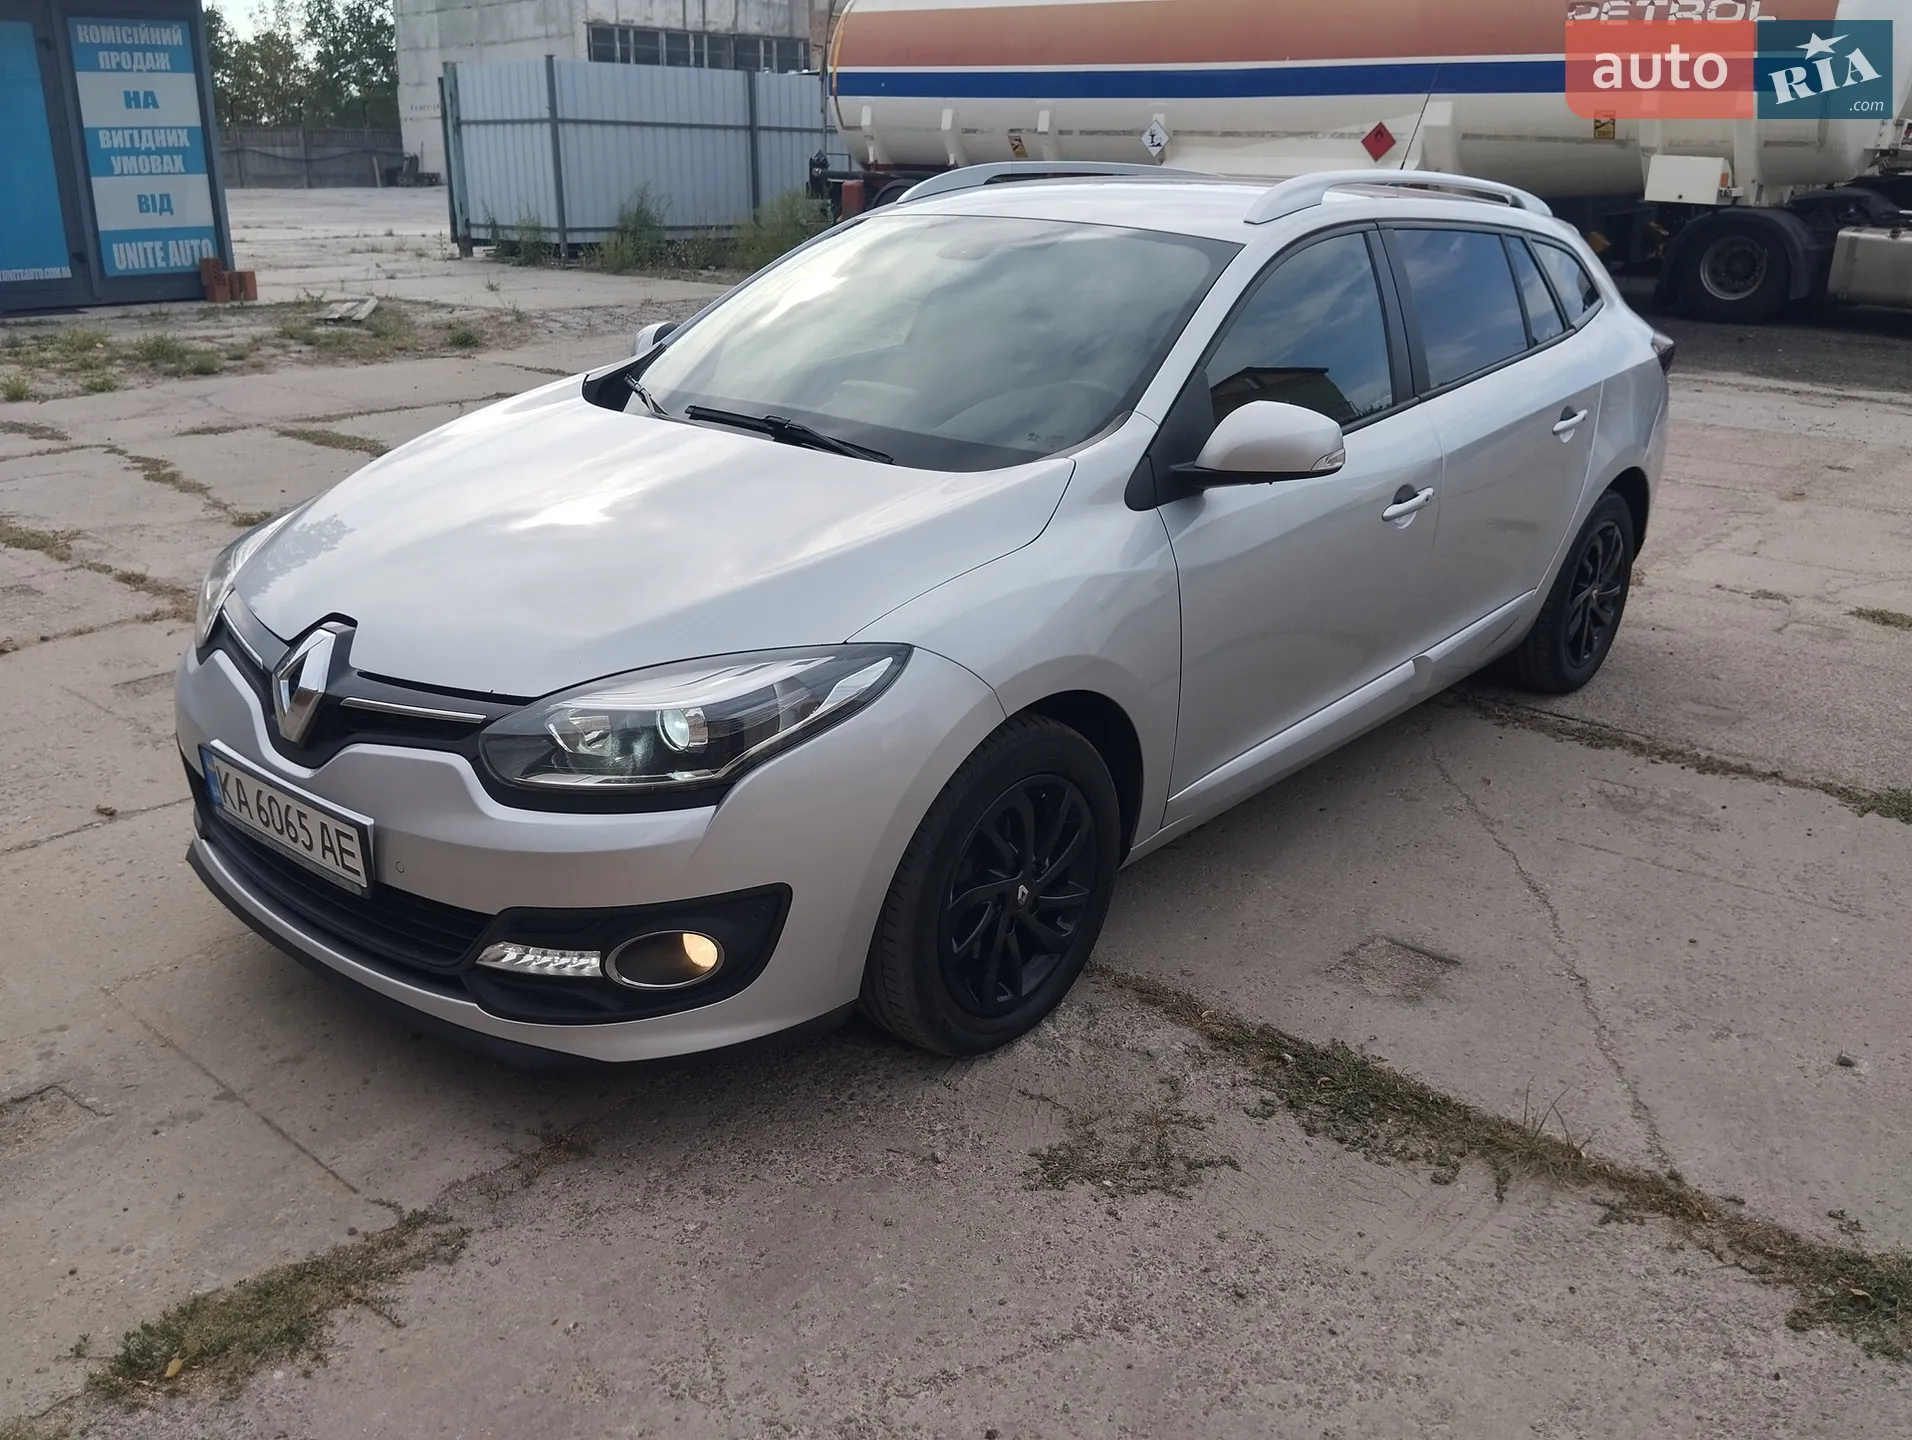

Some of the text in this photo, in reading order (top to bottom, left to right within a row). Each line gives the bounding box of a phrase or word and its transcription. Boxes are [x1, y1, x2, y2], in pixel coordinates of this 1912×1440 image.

[1565, 0, 1777, 26] PETROL
[76, 22, 183, 46] КОМІСІЙНИЙ
[98, 50, 172, 73] ПРОДАЖ
[123, 90, 160, 109] НА
[98, 128, 190, 151] ВИГІДНИХ
[110, 154, 186, 175] УМОВАХ
[137, 193, 174, 216] ВІД
[112, 238, 215, 271] UNITE AUTO
[216, 765, 254, 821] KA
[256, 789, 314, 851] 6065
[320, 821, 361, 877] AE
